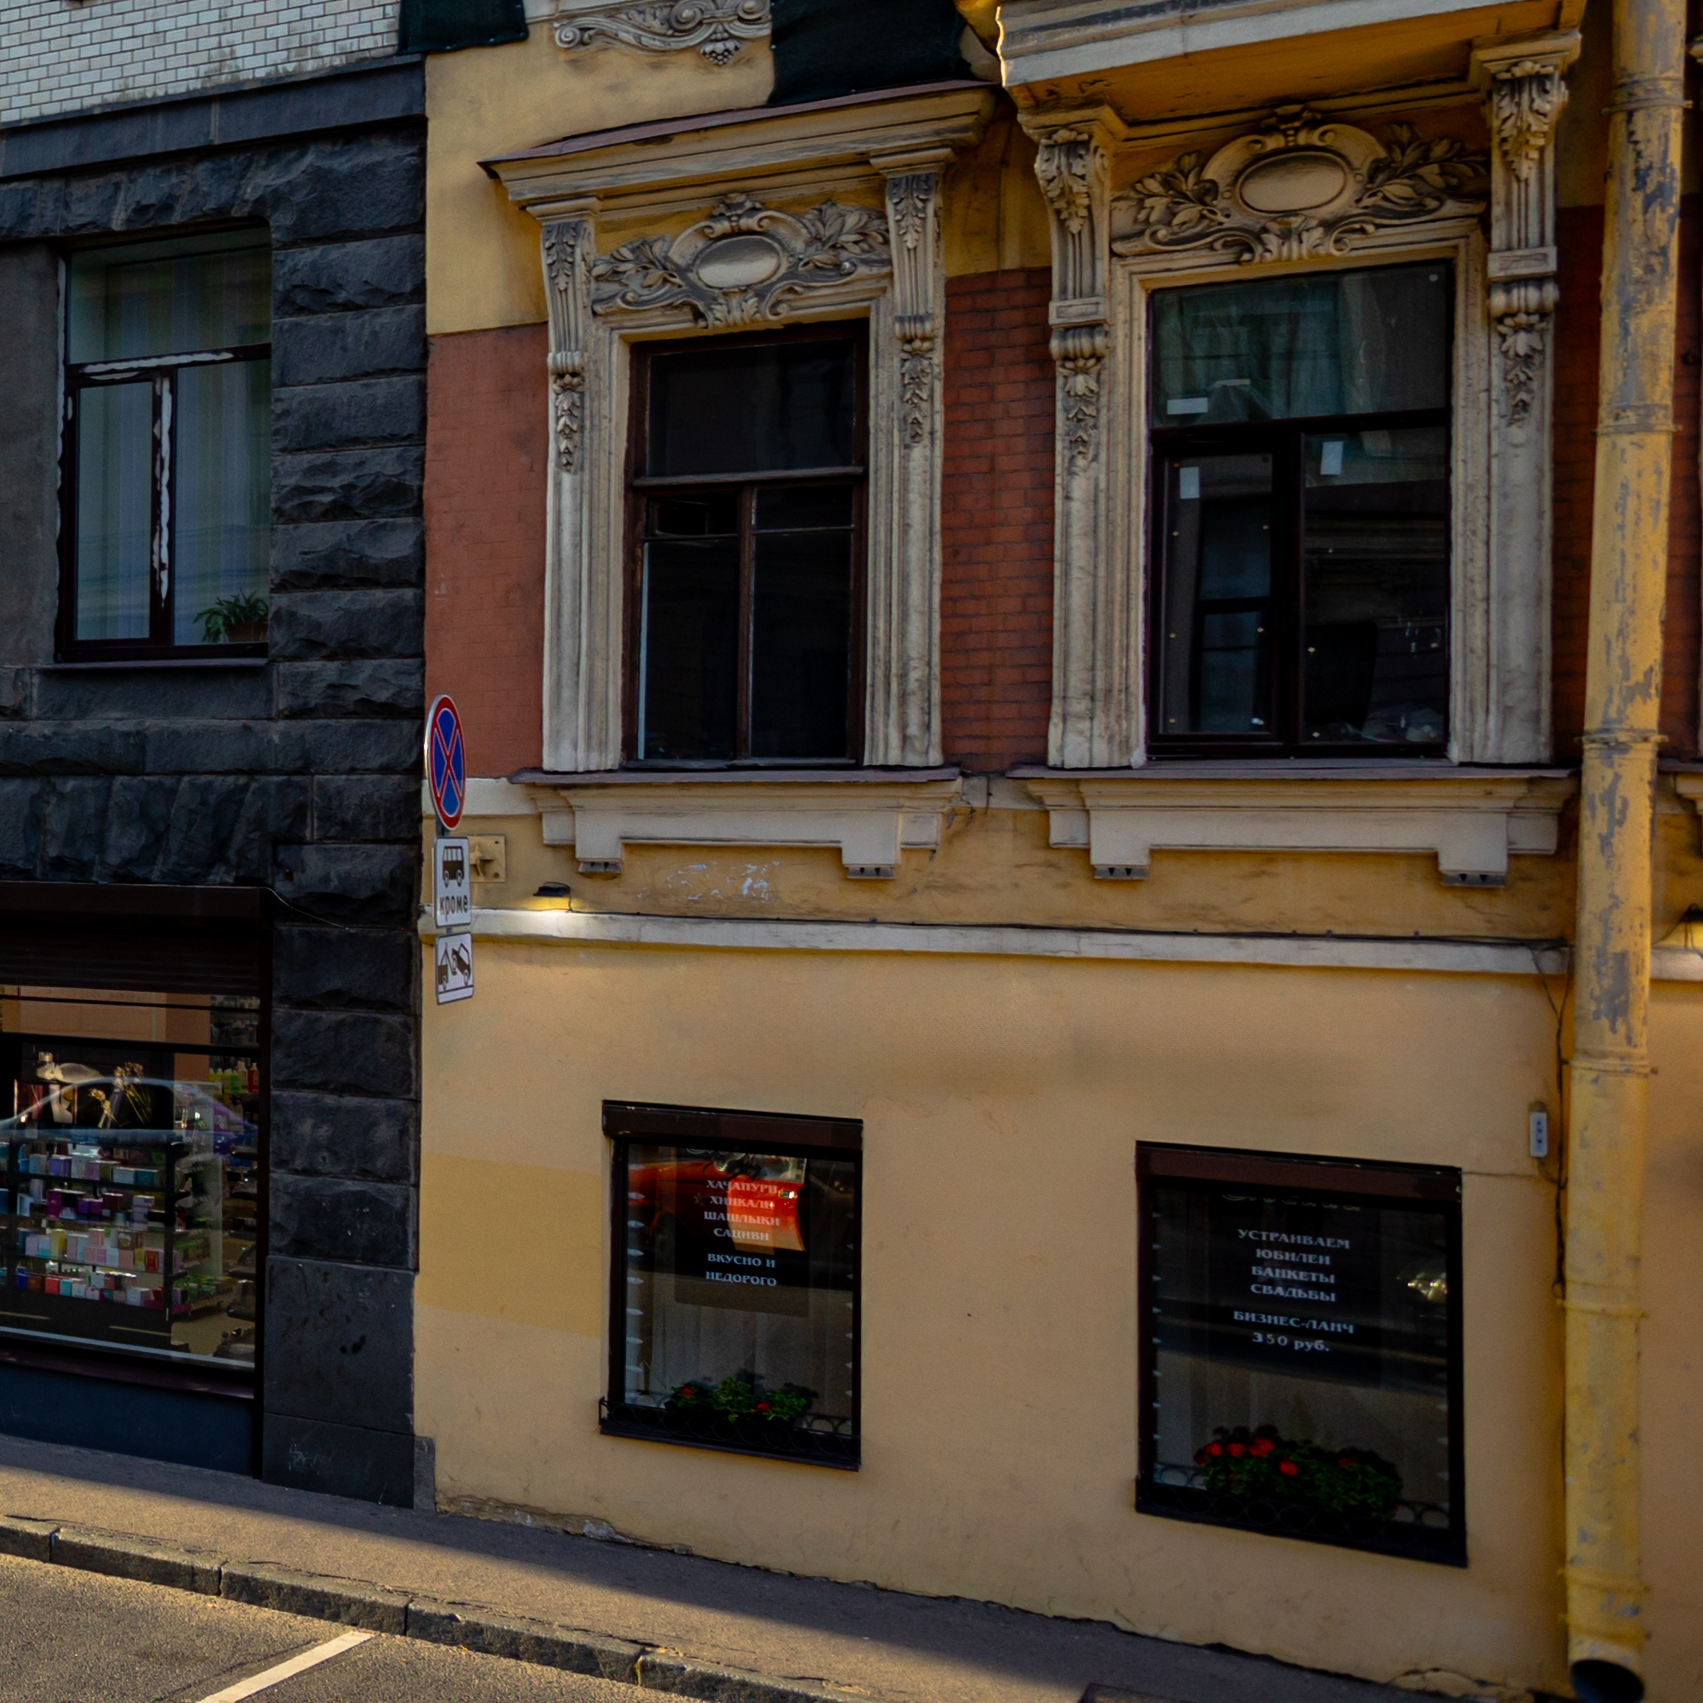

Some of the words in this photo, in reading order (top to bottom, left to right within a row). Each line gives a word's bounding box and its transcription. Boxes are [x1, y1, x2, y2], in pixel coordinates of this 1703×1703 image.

[439, 895, 468, 922] кроме
[706, 1179, 778, 1194] ХАЧАПУРИ
[710, 1195, 775, 1210] ХИНКАЛИ
[703, 1211, 781, 1227] ШАШЛЫКИ
[713, 1227, 770, 1241] САЦИВИ
[1237, 1229, 1351, 1250] УСТРАИВАЕМ
[707, 1253, 762, 1267] ВКУСНО
[765, 1258, 776, 1269] И
[1255, 1248, 1332, 1266] ЮБИЛЕИ
[705, 1271, 778, 1287] НЕДОРОГО
[1251, 1266, 1336, 1285] БАНКЕТЫ
[1250, 1284, 1337, 1303] СВАДЬБЫ
[1233, 1311, 1355, 1335] БИЗНЕС-ЛАНЧ
[1252, 1332, 1288, 1347] 350
[1293, 1340, 1331, 1353] руб.
